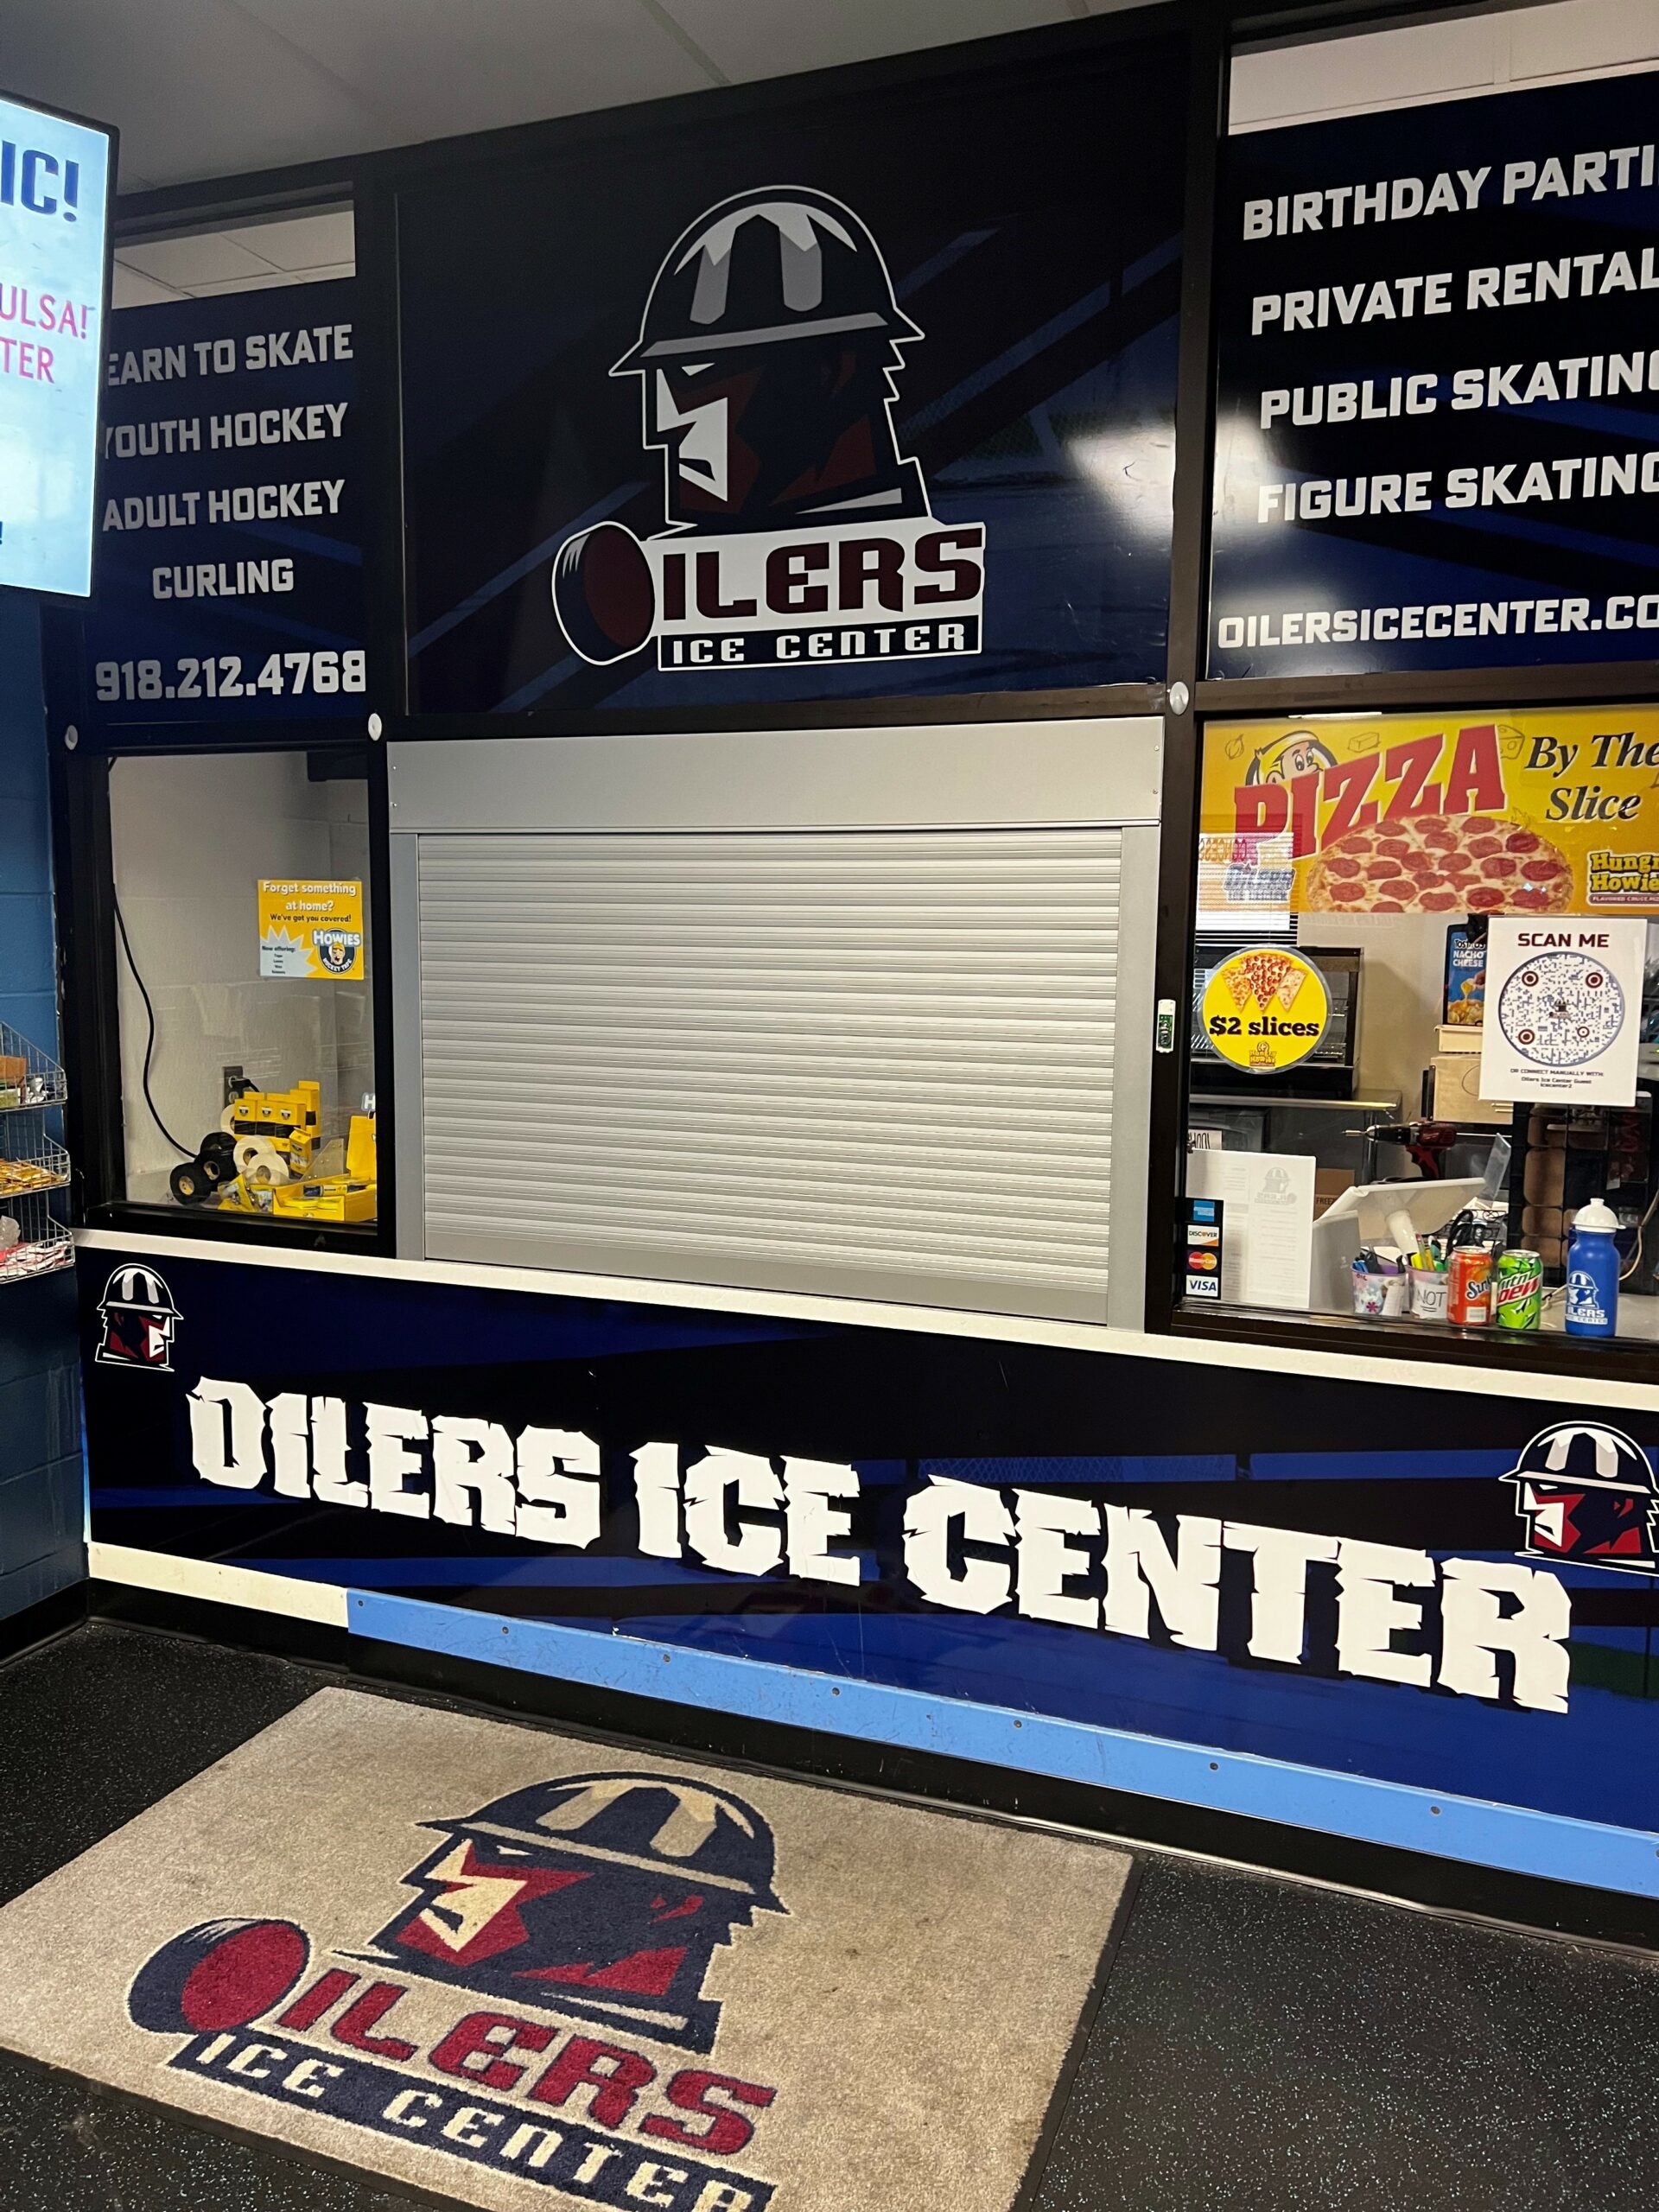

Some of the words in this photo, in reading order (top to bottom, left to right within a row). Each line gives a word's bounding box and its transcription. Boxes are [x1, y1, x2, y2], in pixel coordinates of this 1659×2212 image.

[1243, 167, 1491, 240] BIRTHDAY
[0, 283, 87, 340] ULSA!
[1251, 272, 1452, 335] PRIVATE
[1466, 247, 1659, 310] RENTAL
[194, 339, 236, 375] TO
[245, 324, 353, 371] SKATE
[1260, 373, 1438, 429] PUBLIC
[210, 402, 348, 448] HOCKEY
[103, 492, 200, 531] ADULT
[208, 480, 346, 523] HOCKEY
[1258, 472, 1433, 523] FIGURE
[152, 558, 294, 599] CURLING
[673, 638, 744, 664] ICE
[776, 623, 964, 659] CENTER
[96, 650, 366, 701] 918.212.4768
[1524, 736, 1579, 778] By
[1591, 732, 1659, 767] The
[1235, 724, 1506, 866] PIZZA
[1546, 785, 1641, 821] Slice
[263, 881, 299, 895] Forget
[302, 883, 356, 897] something
[286, 901, 297, 911] at
[299, 900, 334, 912] home?
[313, 930, 360, 945] HOWIES
[1452, 950, 1484, 959] NACHO
[1518, 933, 1572, 947] SCAN
[1579, 933, 1610, 948] ME
[1210, 1015, 1242, 1036] $2
[1249, 1016, 1319, 1036] slices
[1189, 1280, 1217, 1292] VISA
[1418, 1290, 1447, 1307] NOT
[185, 1376, 603, 1549] OILERS
[629, 1440, 861, 1587] ICE
[902, 1473, 1573, 1714] CENTER
[196, 2031, 346, 2097] ICE
[381, 2088, 753, 2212] CENTER
